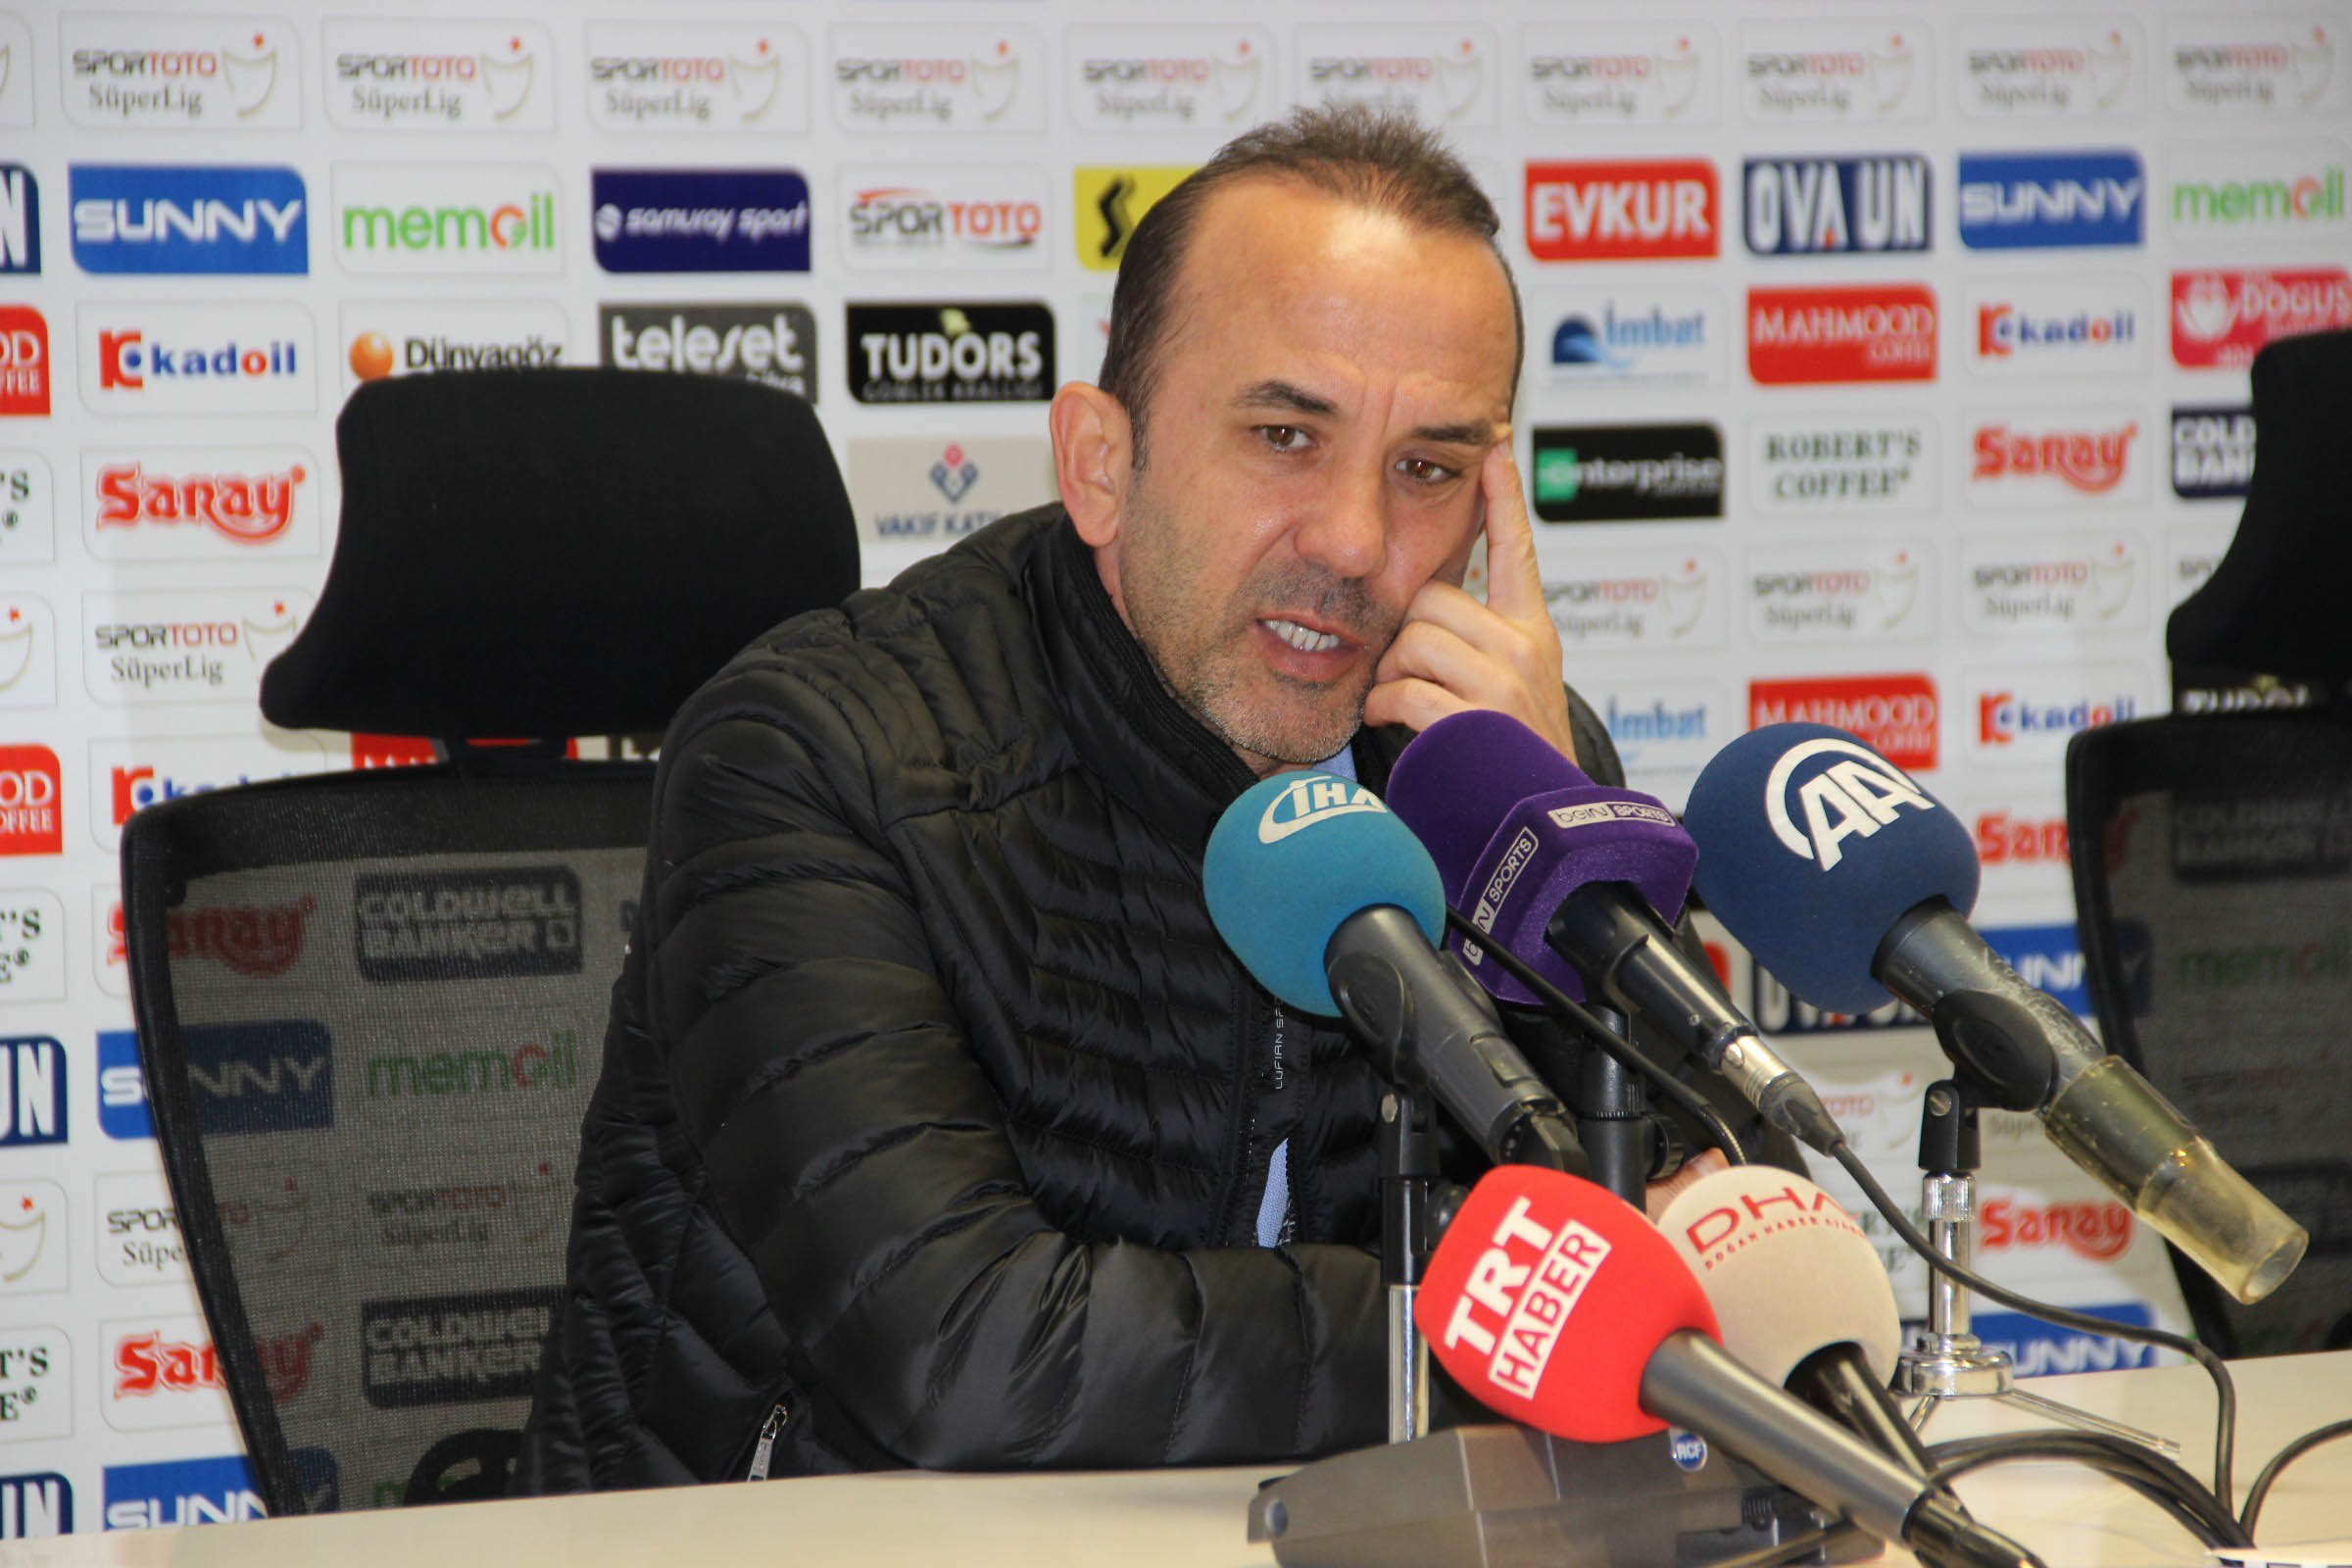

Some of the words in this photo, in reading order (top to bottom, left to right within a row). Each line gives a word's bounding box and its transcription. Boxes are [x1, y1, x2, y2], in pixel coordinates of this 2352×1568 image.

[74, 199, 301, 243] SUNNY
[343, 193, 554, 250] memoil
[738, 200, 807, 243] sport
[1531, 180, 1709, 241] EVKUR
[1749, 163, 1848, 253] OVA
[1857, 160, 1926, 248] UN
[1961, 179, 2140, 224] SUNNY
[612, 313, 804, 374] teleset
[1755, 305, 1935, 345] MAHMOOD
[150, 342, 297, 376] kadoil
[860, 331, 1043, 381] TUDORS
[1973, 421, 2138, 496] Saray
[2174, 415, 2256, 447] COLD
[96, 462, 306, 546] Saray
[1755, 697, 1936, 731] MAHMOOD
[1489, 838, 1533, 903] SPORTS
[1274, 1033, 1284, 1090] LUFIAN
[1978, 1196, 2134, 1263] Saray
[1444, 1195, 1553, 1356] TRT
[1495, 1234, 1601, 1390] HABER
[1989, 1335, 2148, 1376] UNNY
